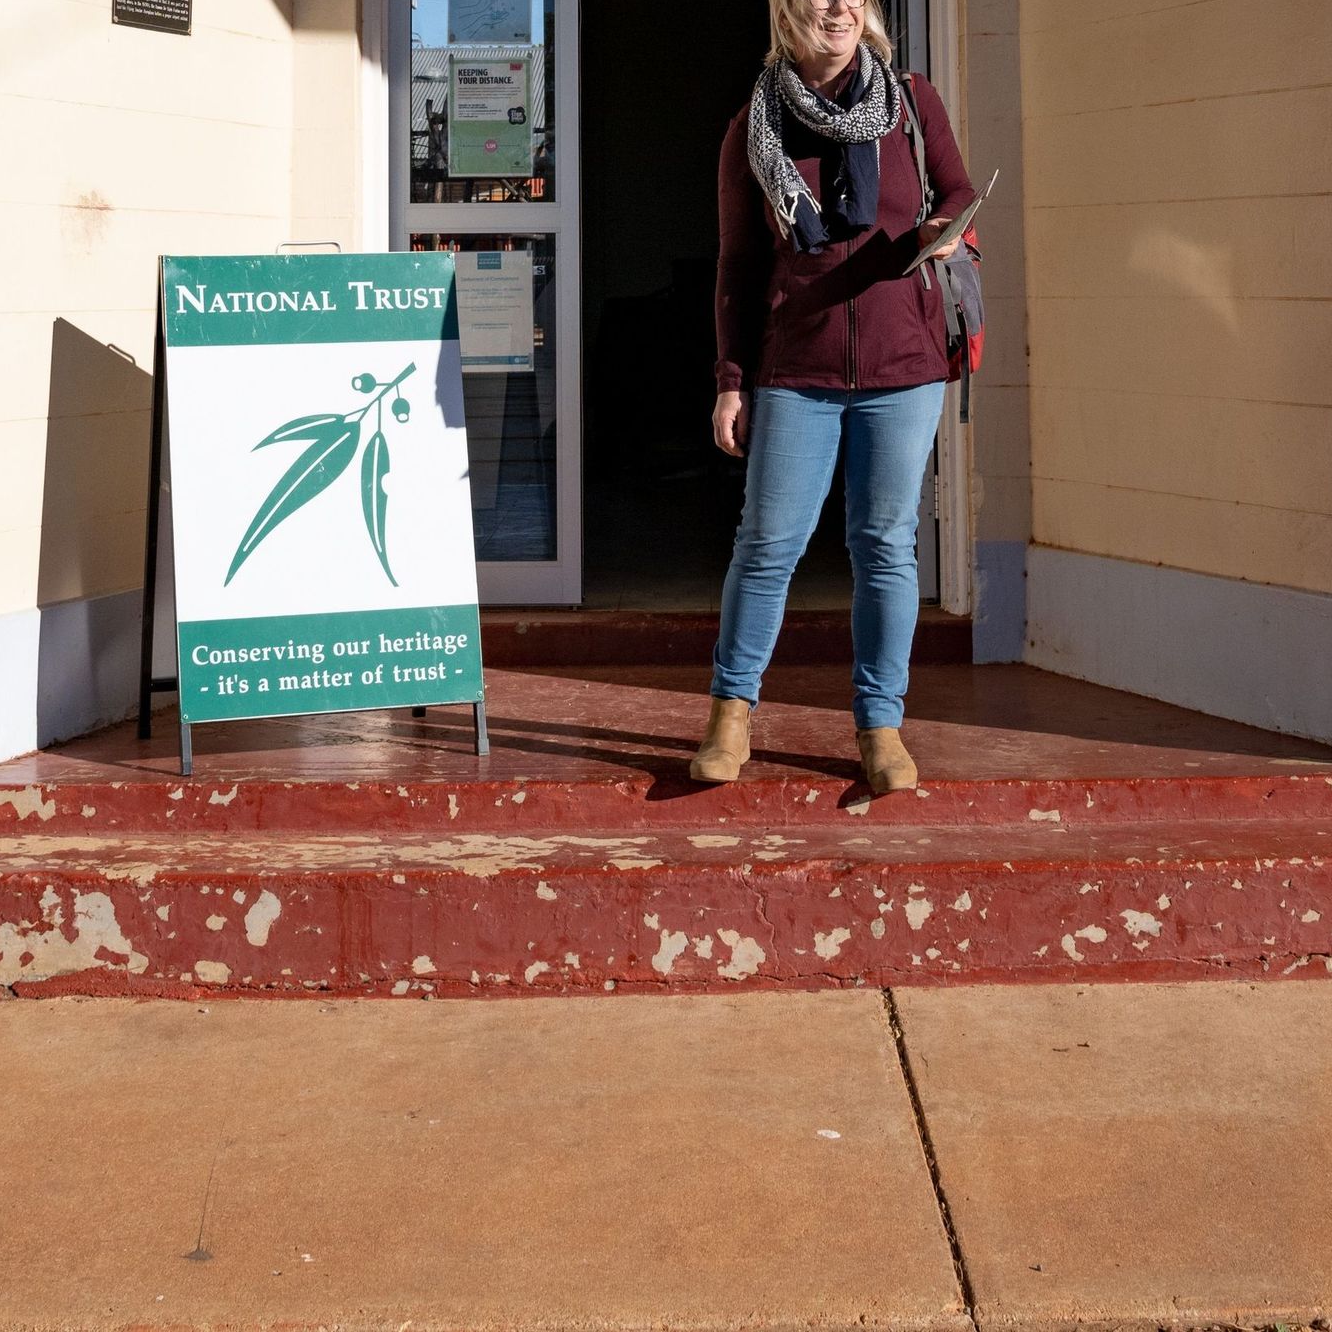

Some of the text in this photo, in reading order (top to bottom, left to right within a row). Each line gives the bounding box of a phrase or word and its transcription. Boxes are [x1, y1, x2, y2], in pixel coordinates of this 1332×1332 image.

[458, 68, 488, 76] KEEPING
[458, 76, 514, 85] YOUR DISTANCE.
[175, 284, 336, 314] NATIONAL
[348, 280, 446, 311] TRUST
[191, 629, 468, 665] Conserving our heritage
[217, 673, 249, 695] it's
[258, 678, 270, 692] a
[278, 670, 353, 690] matter
[361, 664, 384, 686] of
[393, 661, 446, 682] trust
